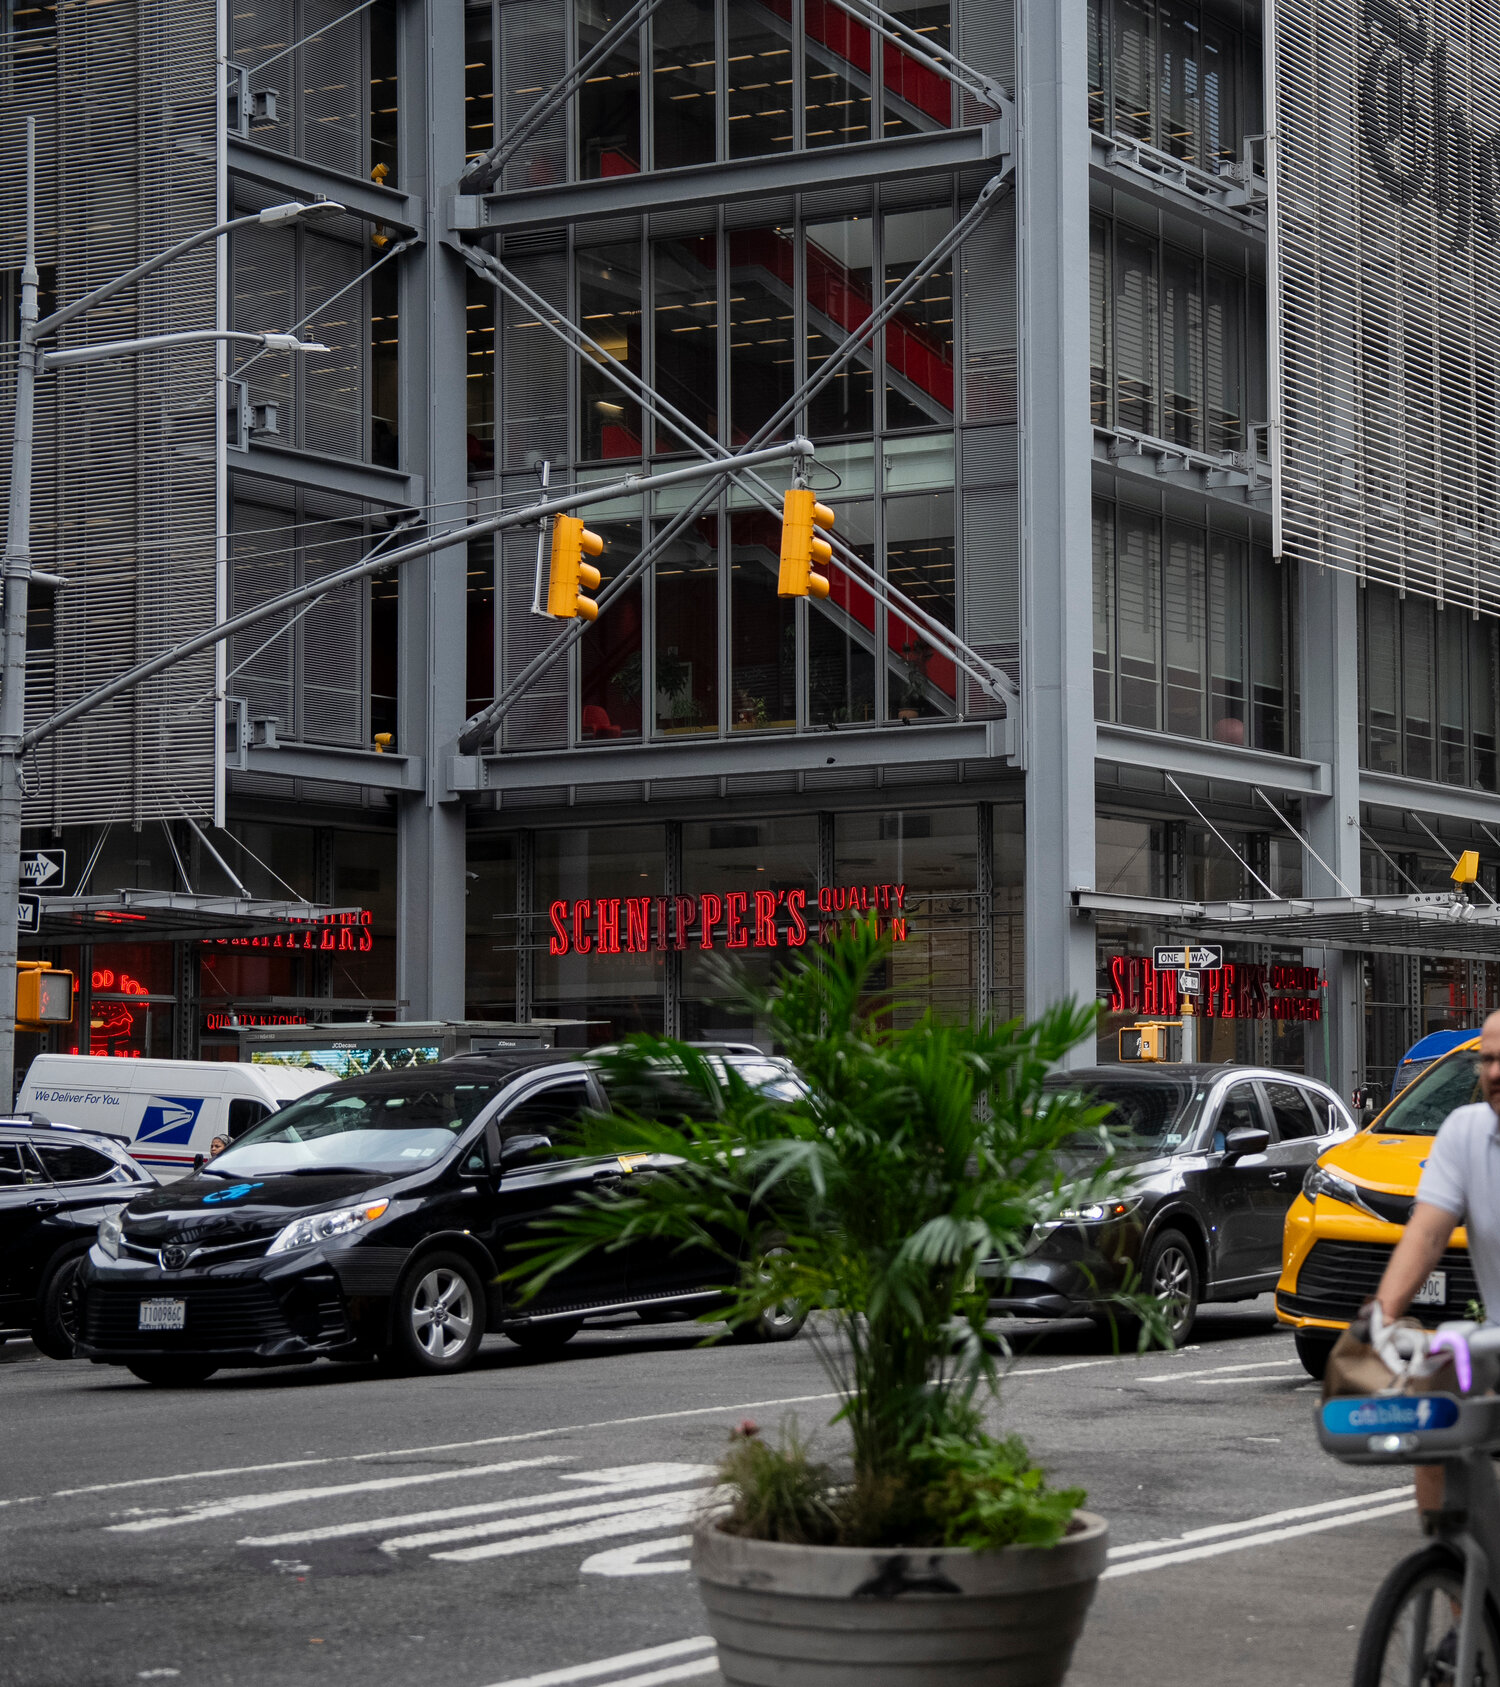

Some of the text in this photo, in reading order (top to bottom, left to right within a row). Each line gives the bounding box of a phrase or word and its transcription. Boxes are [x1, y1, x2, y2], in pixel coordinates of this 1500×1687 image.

[24, 863, 49, 876] WAY
[18, 906, 30, 919] AY
[550, 883, 905, 956] SCHNIPPER'S QUALITY
[1161, 953, 1210, 962] ONE WAY
[207, 1013, 258, 1030] QUAITY
[35, 1090, 120, 1105] We Deliver For You.
